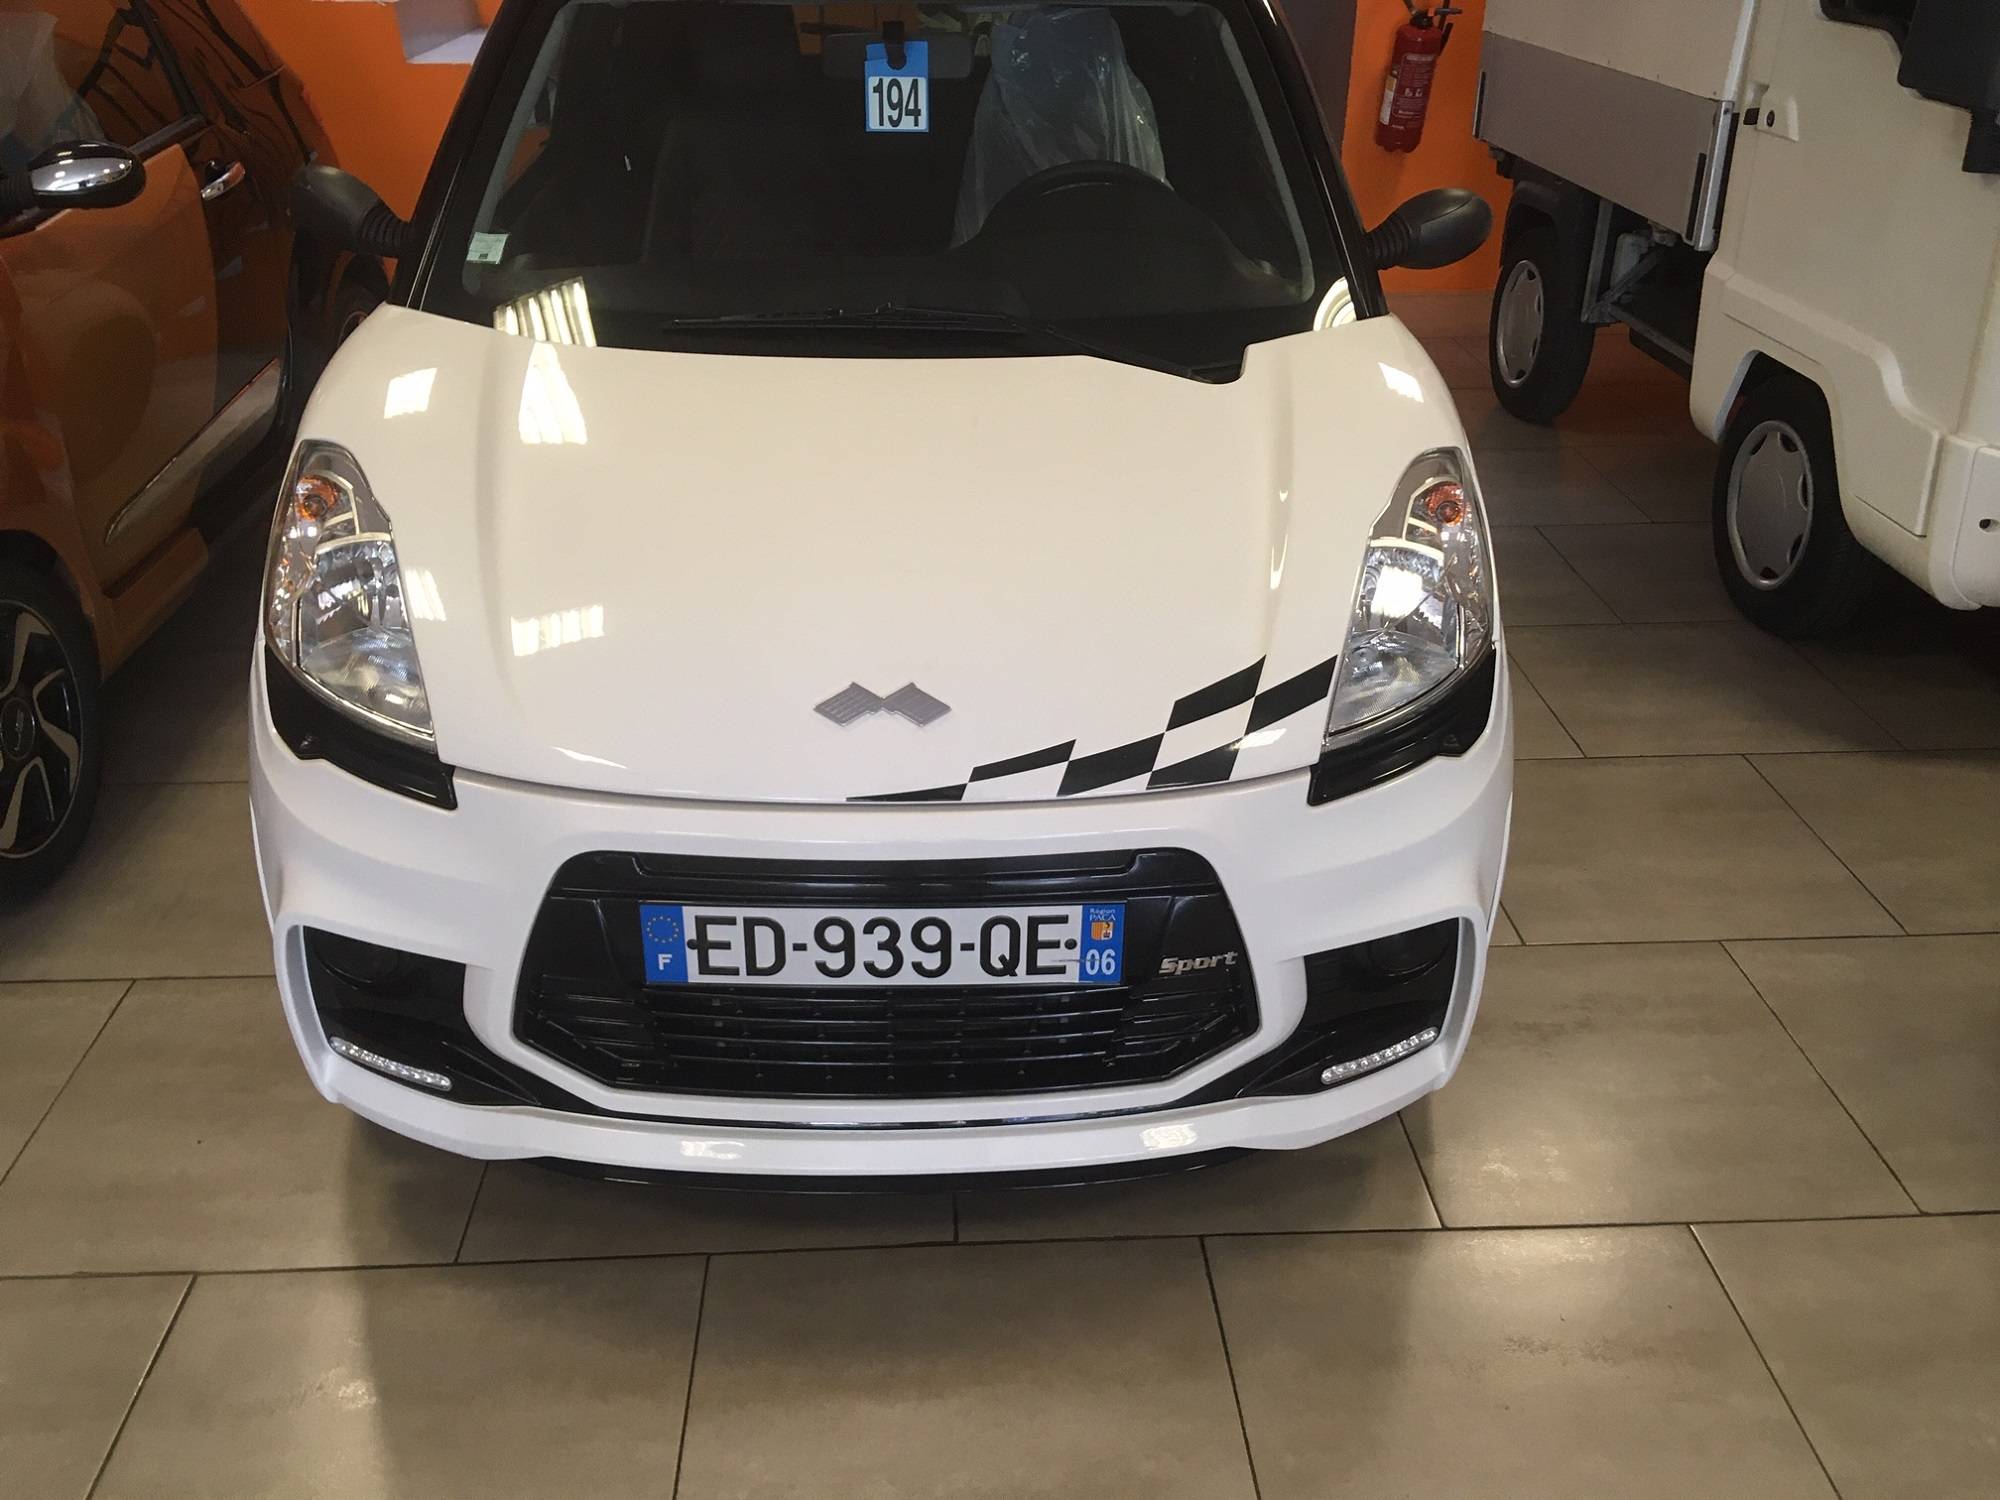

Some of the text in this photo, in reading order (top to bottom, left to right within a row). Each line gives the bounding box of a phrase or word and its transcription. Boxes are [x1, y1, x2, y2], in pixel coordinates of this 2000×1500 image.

[872, 78, 922, 128] 194
[1089, 913, 1116, 921] PACA
[695, 915, 1069, 978] ED-939-QE
[658, 953, 673, 970] F
[1085, 948, 1116, 975] 06
[1158, 951, 1238, 975] Sport
